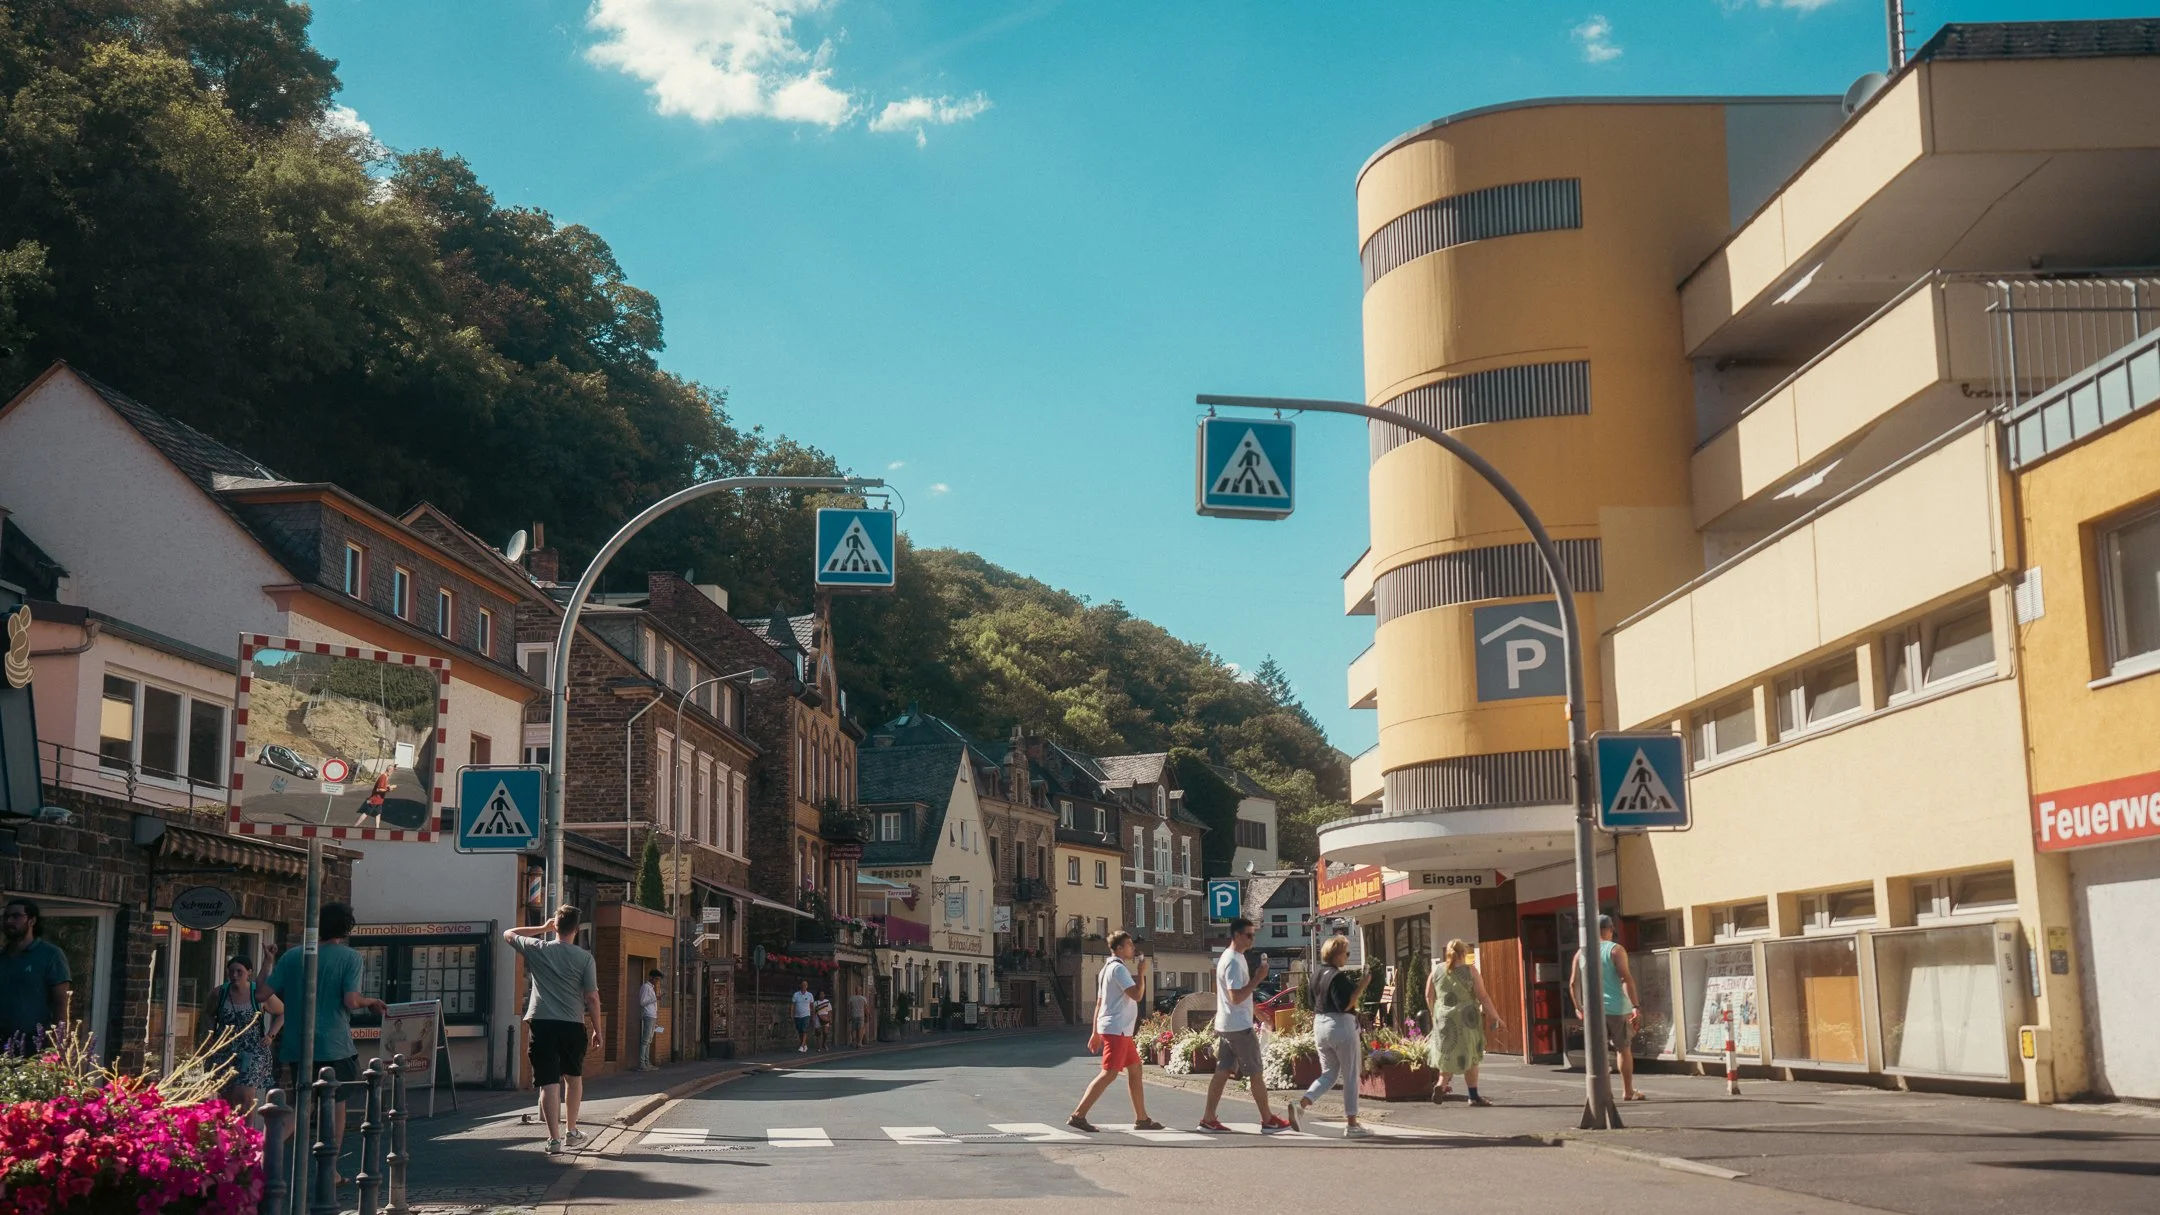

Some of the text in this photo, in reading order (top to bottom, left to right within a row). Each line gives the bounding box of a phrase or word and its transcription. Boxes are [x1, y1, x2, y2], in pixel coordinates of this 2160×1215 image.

[1506, 638, 1546, 689] P
[871, 869, 922, 879] PENSION
[1422, 873, 1482, 886] Eingang
[180, 900, 223, 910] Schmuck
[1216, 891, 1232, 916] P
[201, 909, 224, 917] mehr
